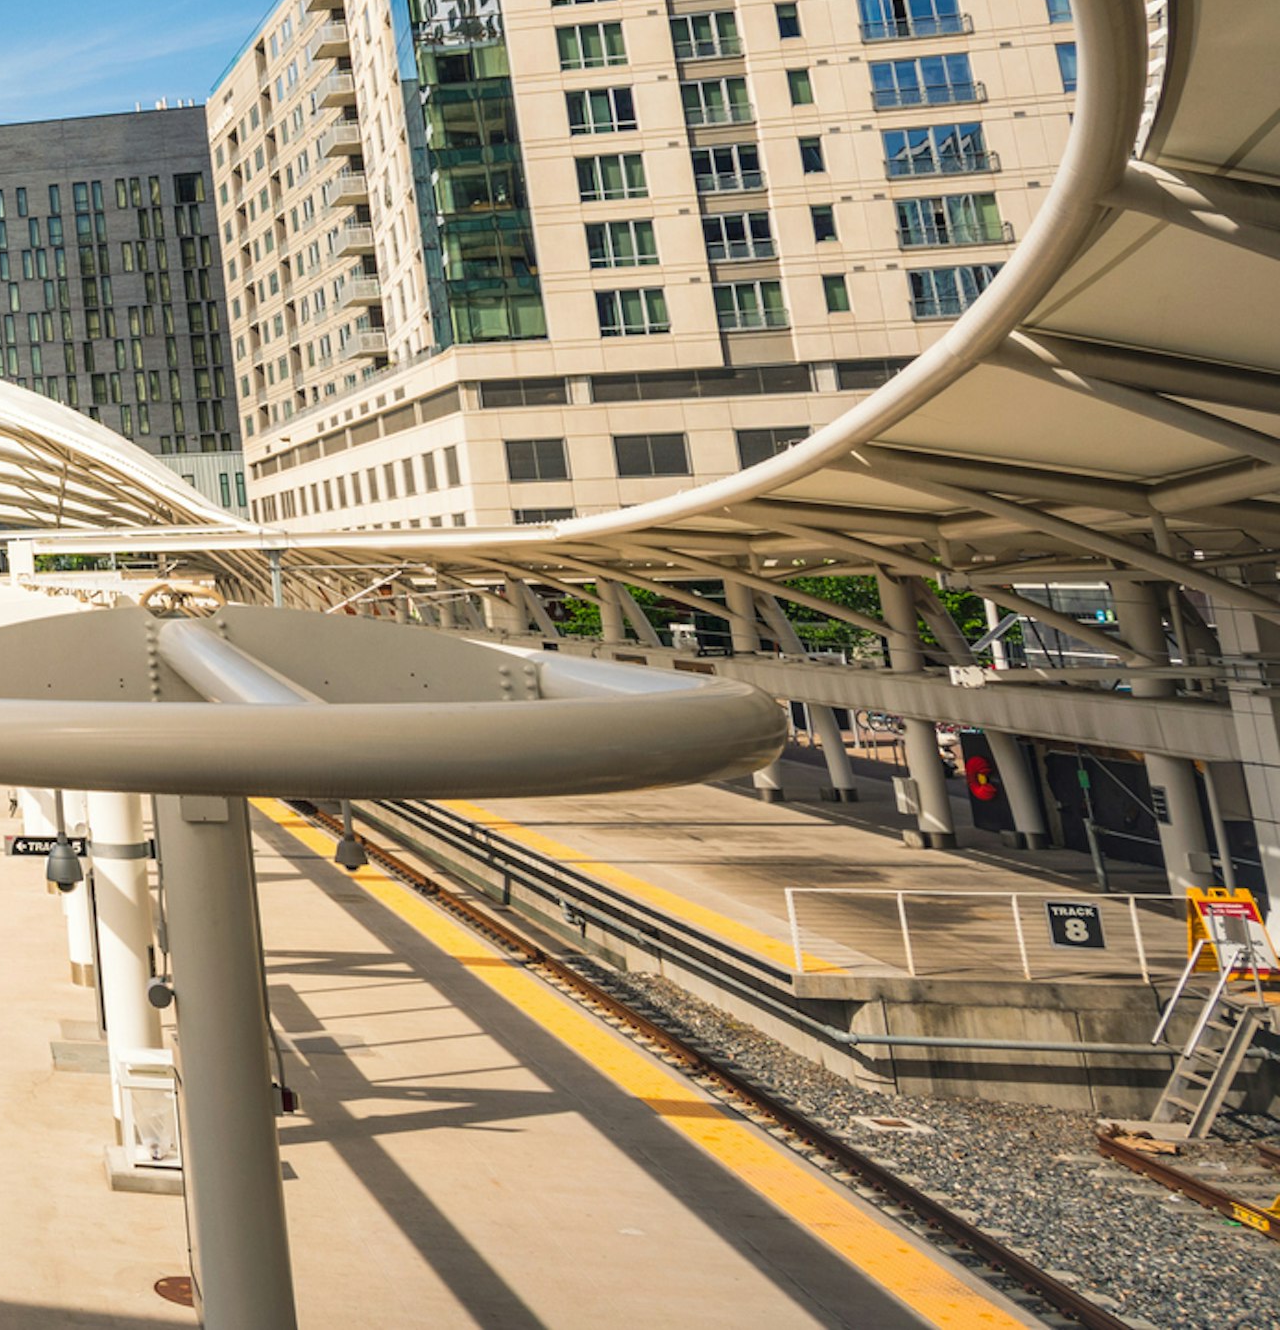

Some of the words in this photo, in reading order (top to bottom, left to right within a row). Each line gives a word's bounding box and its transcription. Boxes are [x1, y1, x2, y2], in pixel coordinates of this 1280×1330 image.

[27, 841, 57, 852] TRA
[72, 841, 82, 853] 5
[1051, 906, 1095, 917] TRACK
[1065, 918, 1089, 942] 8
